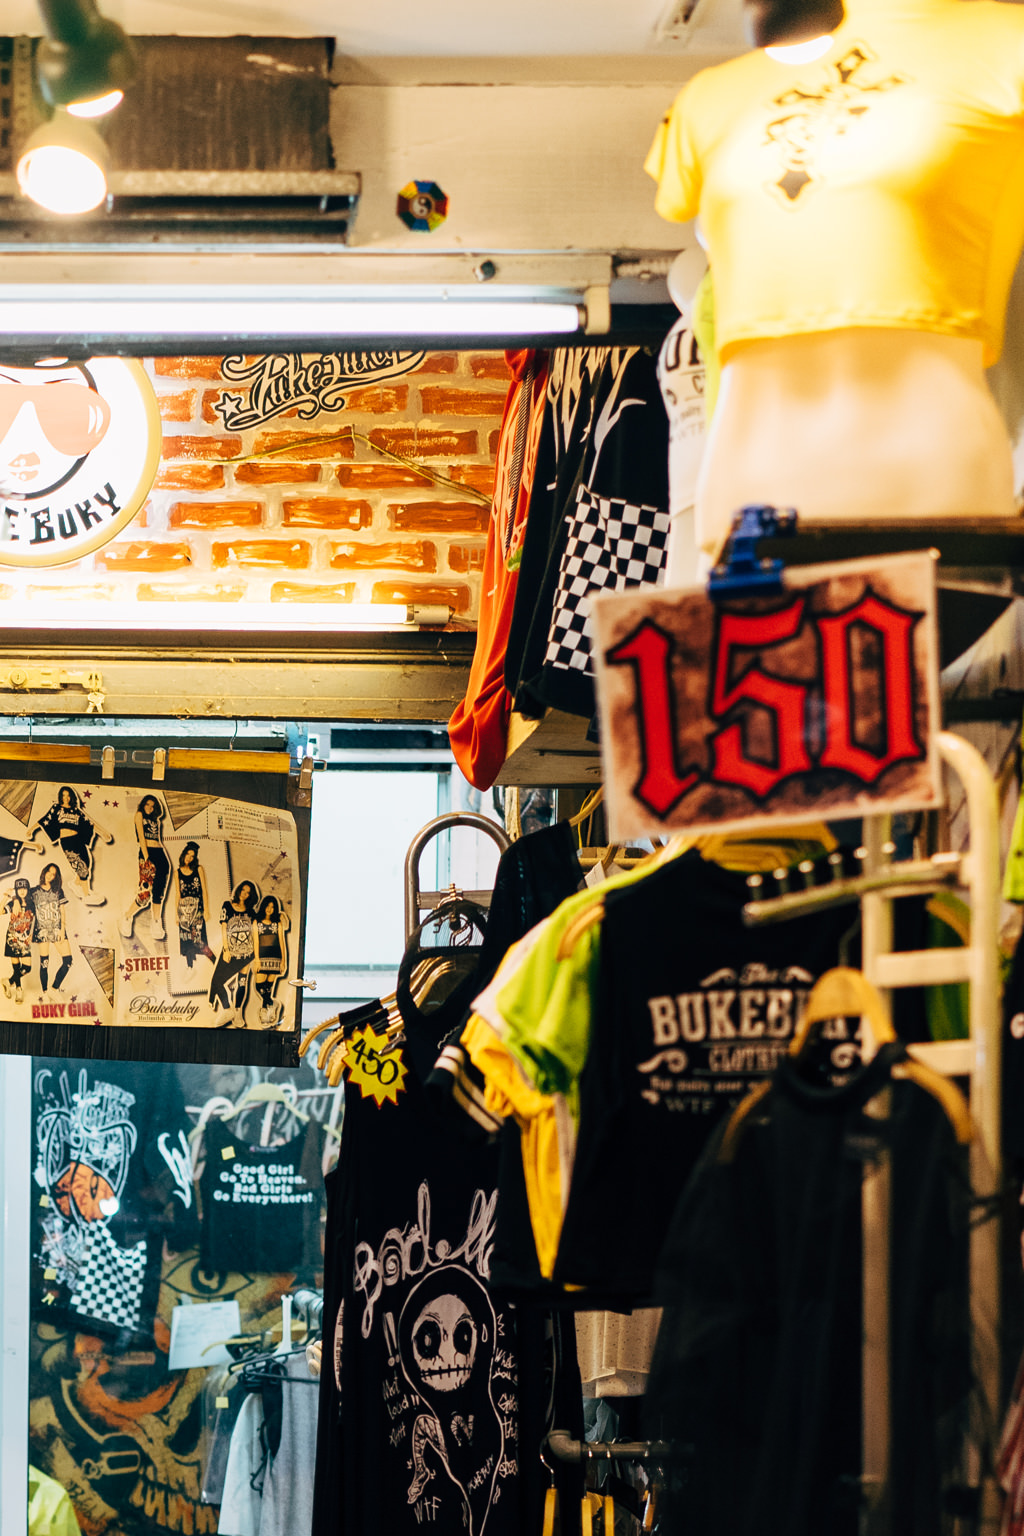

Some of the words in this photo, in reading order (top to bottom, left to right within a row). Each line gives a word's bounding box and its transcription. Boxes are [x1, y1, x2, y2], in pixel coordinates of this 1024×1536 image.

[606, 584, 926, 820] 150
[125, 956, 170, 973] STREET
[32, 1003, 64, 1018] BUKY
[68, 1001, 98, 1017] GIRL
[129, 996, 200, 1022] Bukebuky
[352, 1038, 399, 1086] 450
[220, 1171, 237, 1183] Go
[240, 1173, 255, 1184] To
[258, 1174, 307, 1184] Heaven.
[233, 1163, 266, 1174] Good
[268, 1164, 294, 1175] Girl
[233, 1182, 257, 1194] Bad
[260, 1184, 293, 1194] Girls
[213, 1190, 230, 1201] Go
[233, 1192, 313, 1205] Everywhere!
